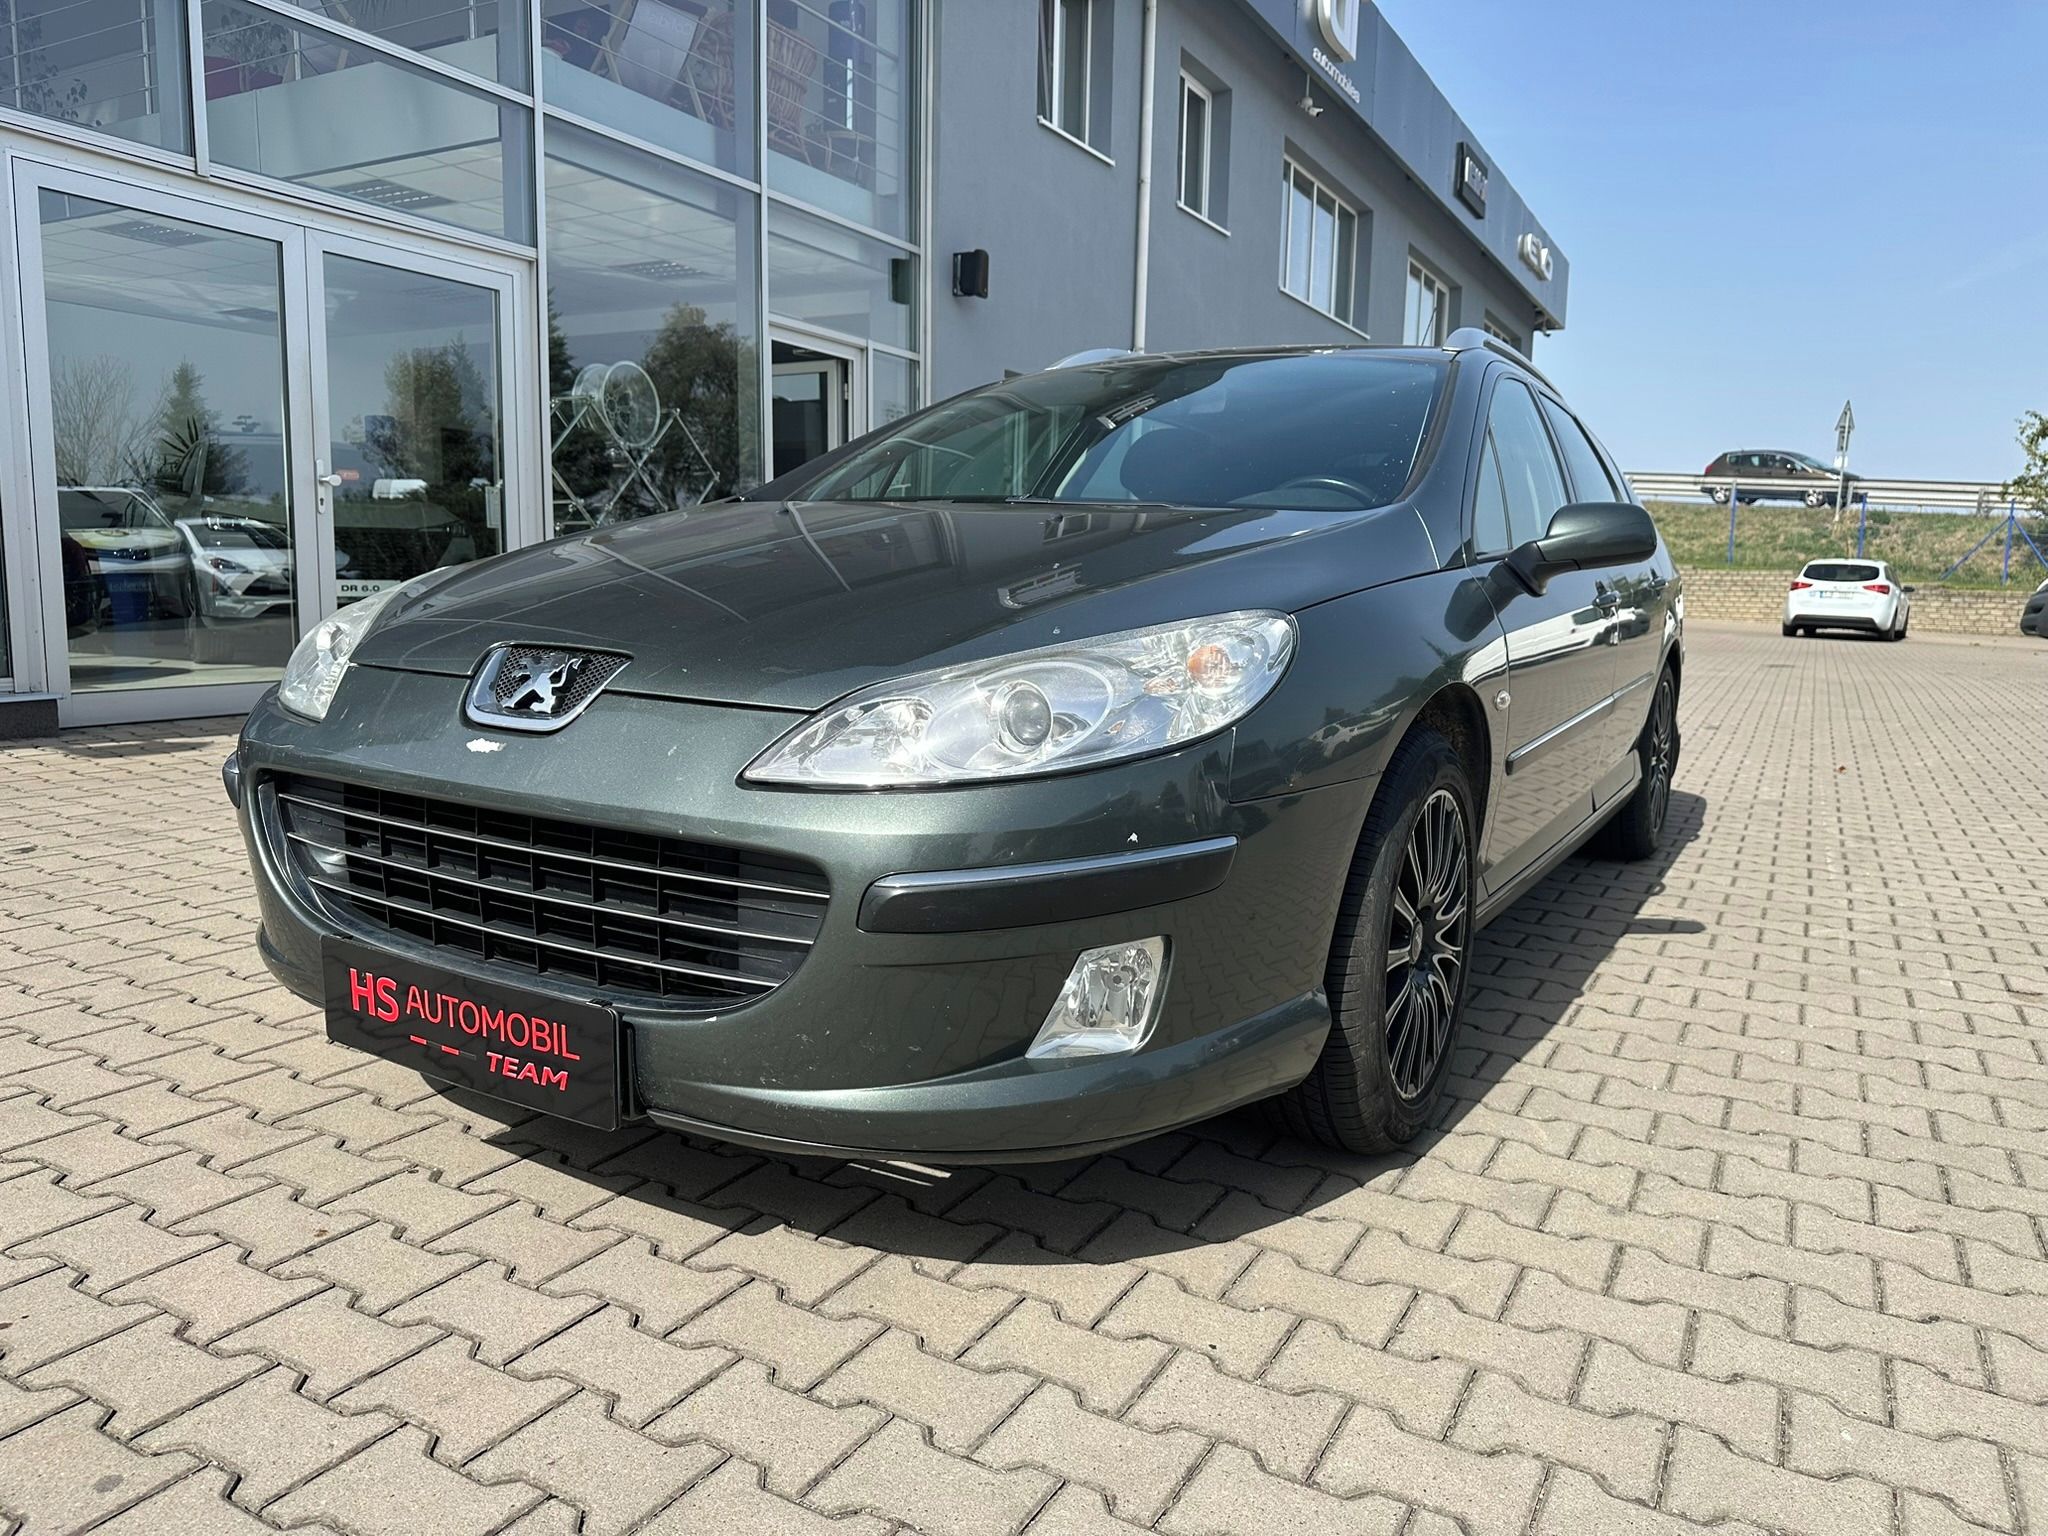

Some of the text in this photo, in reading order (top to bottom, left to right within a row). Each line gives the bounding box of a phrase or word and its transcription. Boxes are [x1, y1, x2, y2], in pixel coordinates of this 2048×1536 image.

[341, 584, 380, 592] DR 6.0
[349, 967, 581, 1061] HS AUTOMOBIL
[486, 1051, 569, 1091] TEAM
